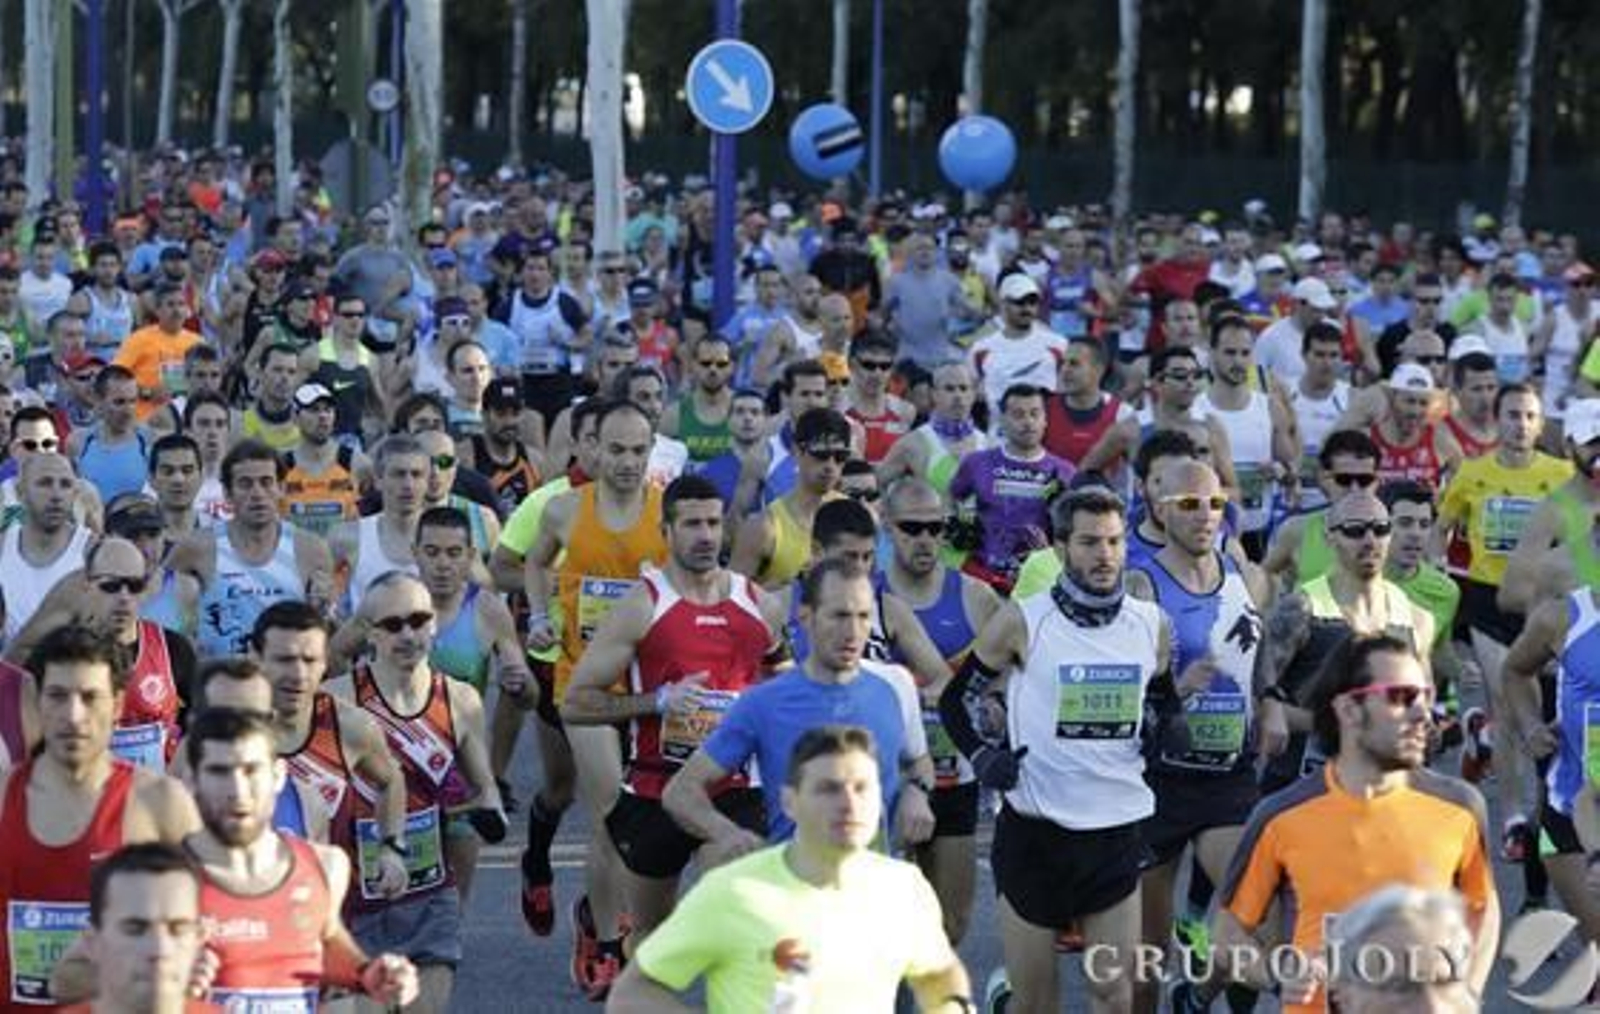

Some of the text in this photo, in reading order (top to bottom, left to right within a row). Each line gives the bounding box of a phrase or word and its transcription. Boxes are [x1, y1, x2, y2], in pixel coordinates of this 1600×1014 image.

[1088, 669, 1134, 680] ZURICH
[1082, 692, 1122, 709] 1011
[1201, 701, 1241, 711] ZURICH
[44, 912, 91, 926] ZURIC
